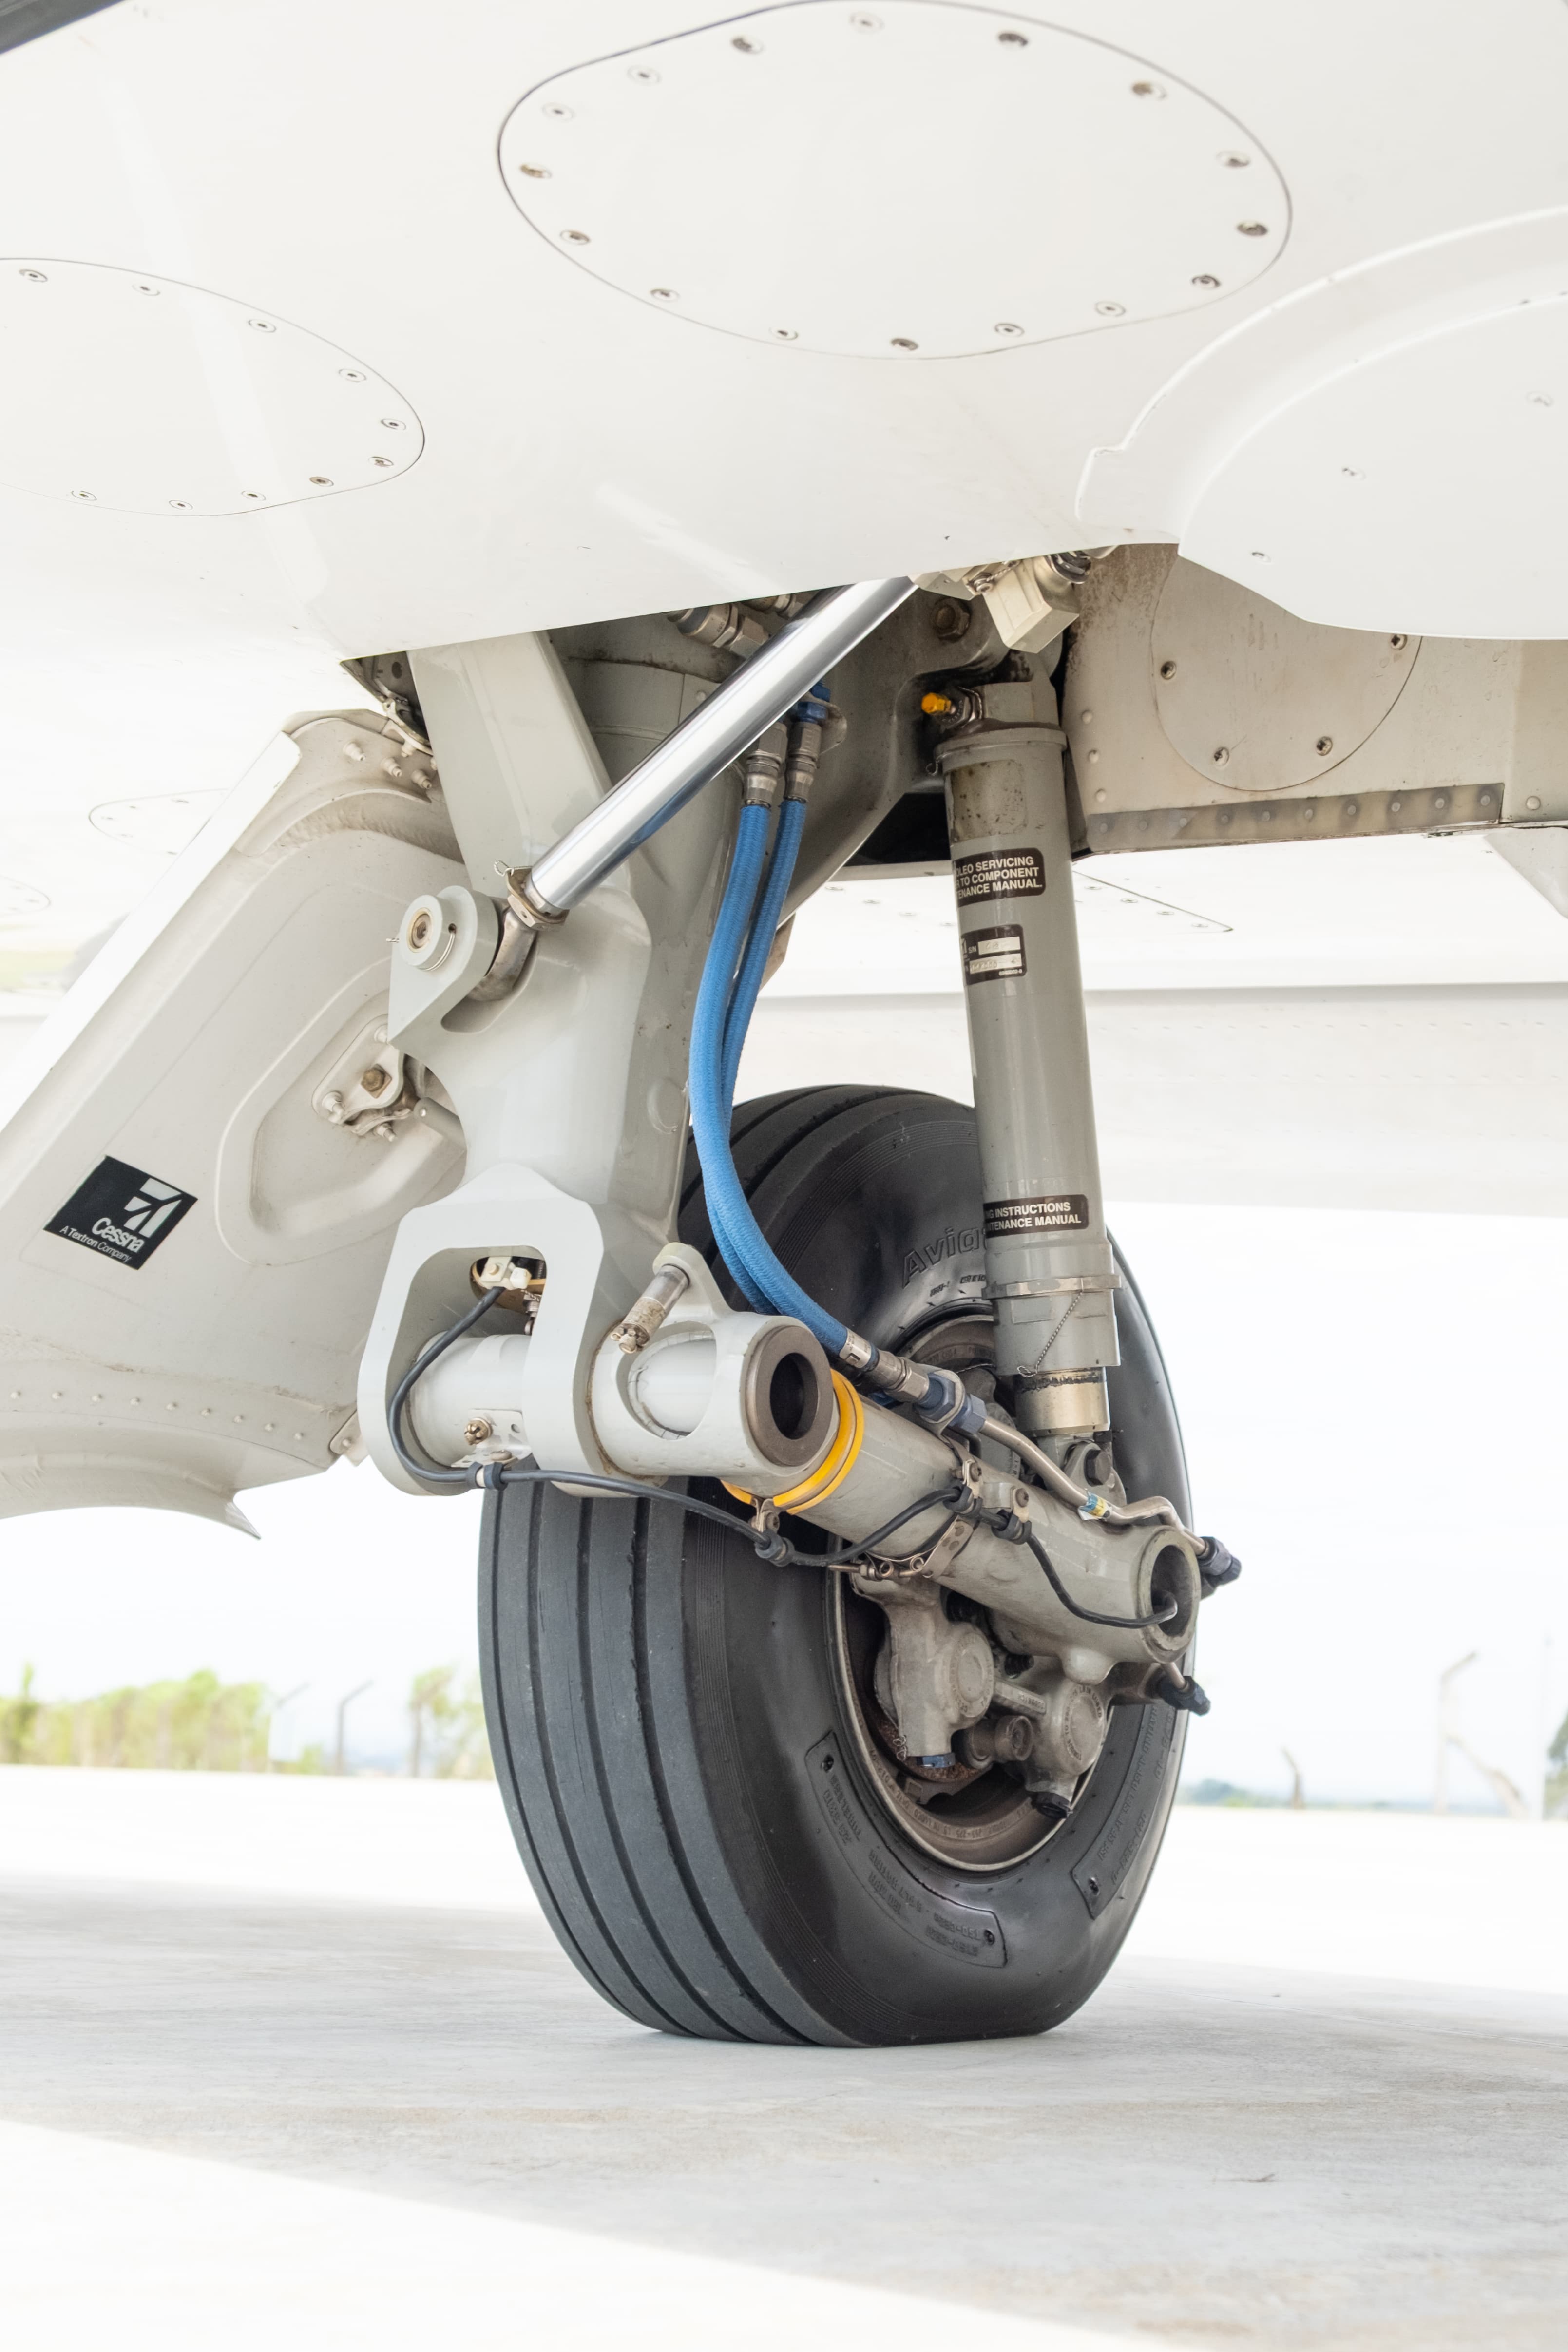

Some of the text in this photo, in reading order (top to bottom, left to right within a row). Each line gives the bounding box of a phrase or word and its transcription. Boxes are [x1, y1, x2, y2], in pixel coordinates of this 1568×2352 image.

[975, 856, 1034, 872] SERVICING
[960, 876, 970, 887] TO
[972, 867, 1039, 884] COMPONENT
[992, 878, 1043, 891] MANUAL.
[995, 1202, 1071, 1218] INSTRUCTIONS
[1034, 1213, 1082, 1226] MANUAL
[92, 1217, 144, 1253] Cessna
[59, 1225, 132, 1263] A Textron Company
